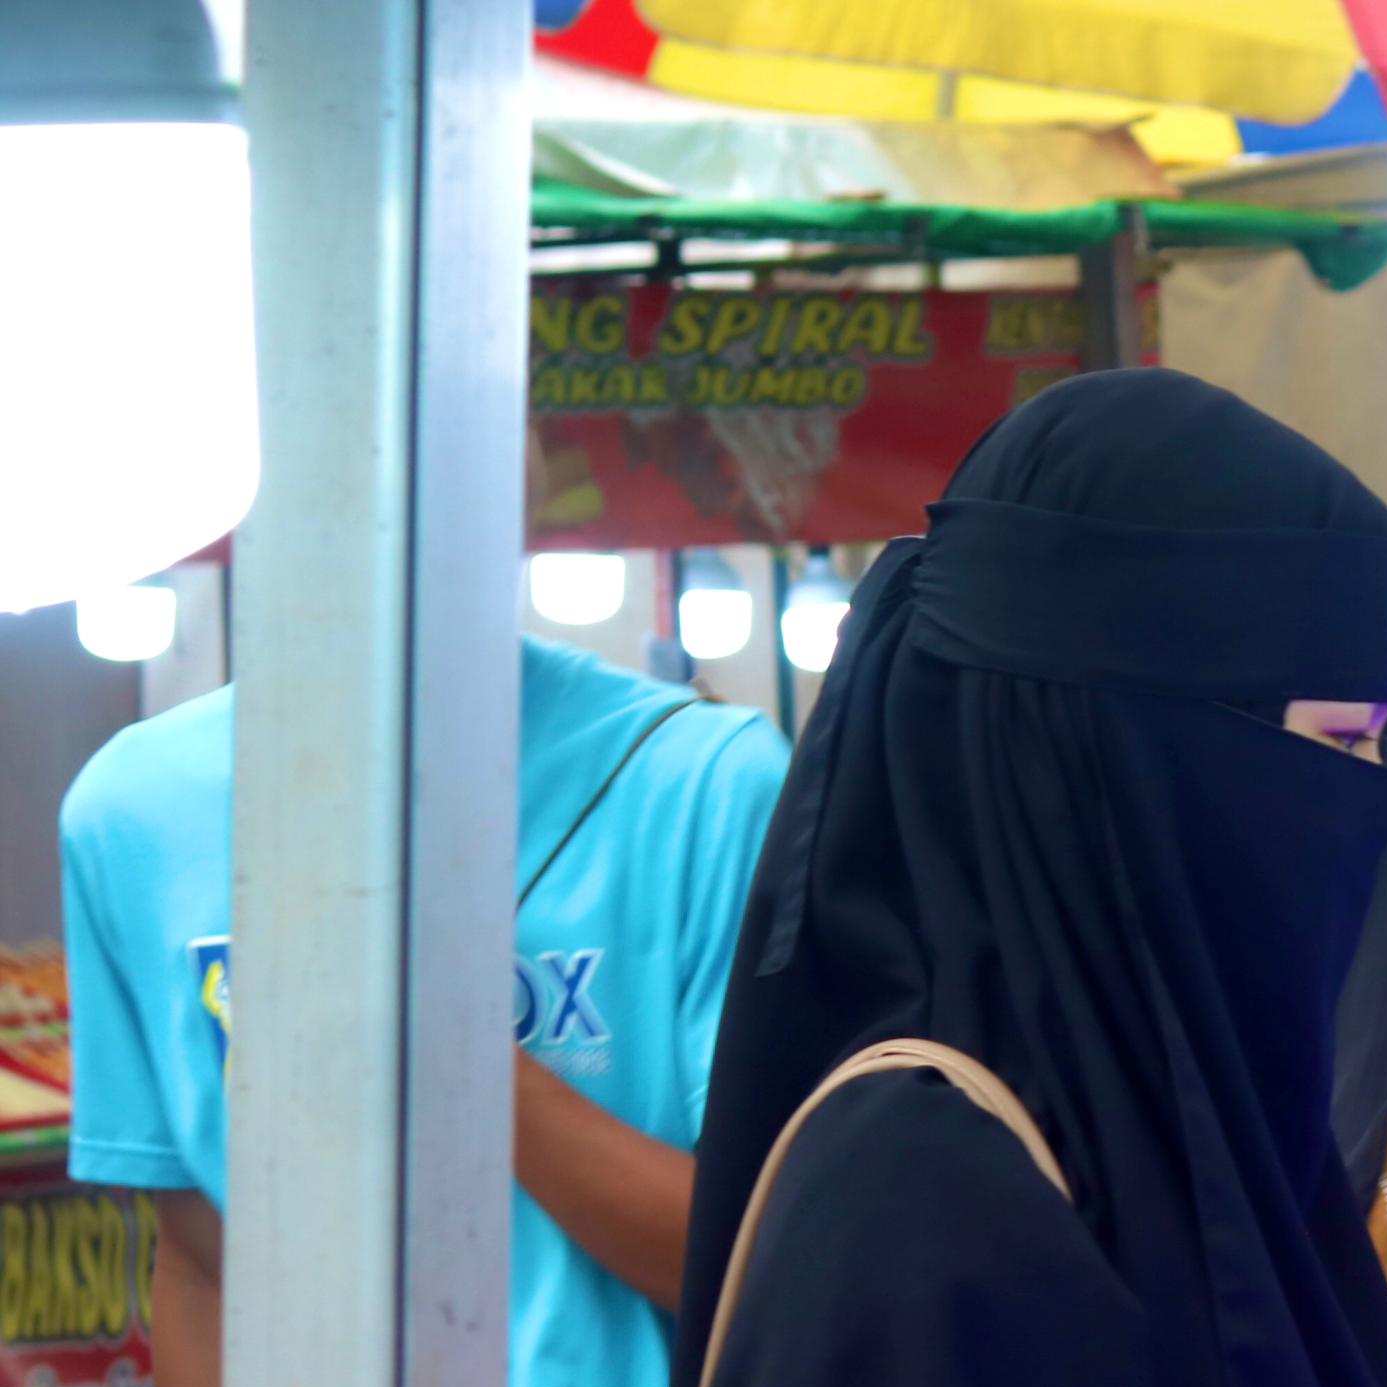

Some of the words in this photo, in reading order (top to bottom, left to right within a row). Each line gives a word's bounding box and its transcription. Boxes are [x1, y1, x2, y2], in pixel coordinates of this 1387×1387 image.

[657, 294, 934, 356] SPIRAL
[686, 363, 867, 407] JUMBO
[2, 1193, 130, 1344] BAKSO
